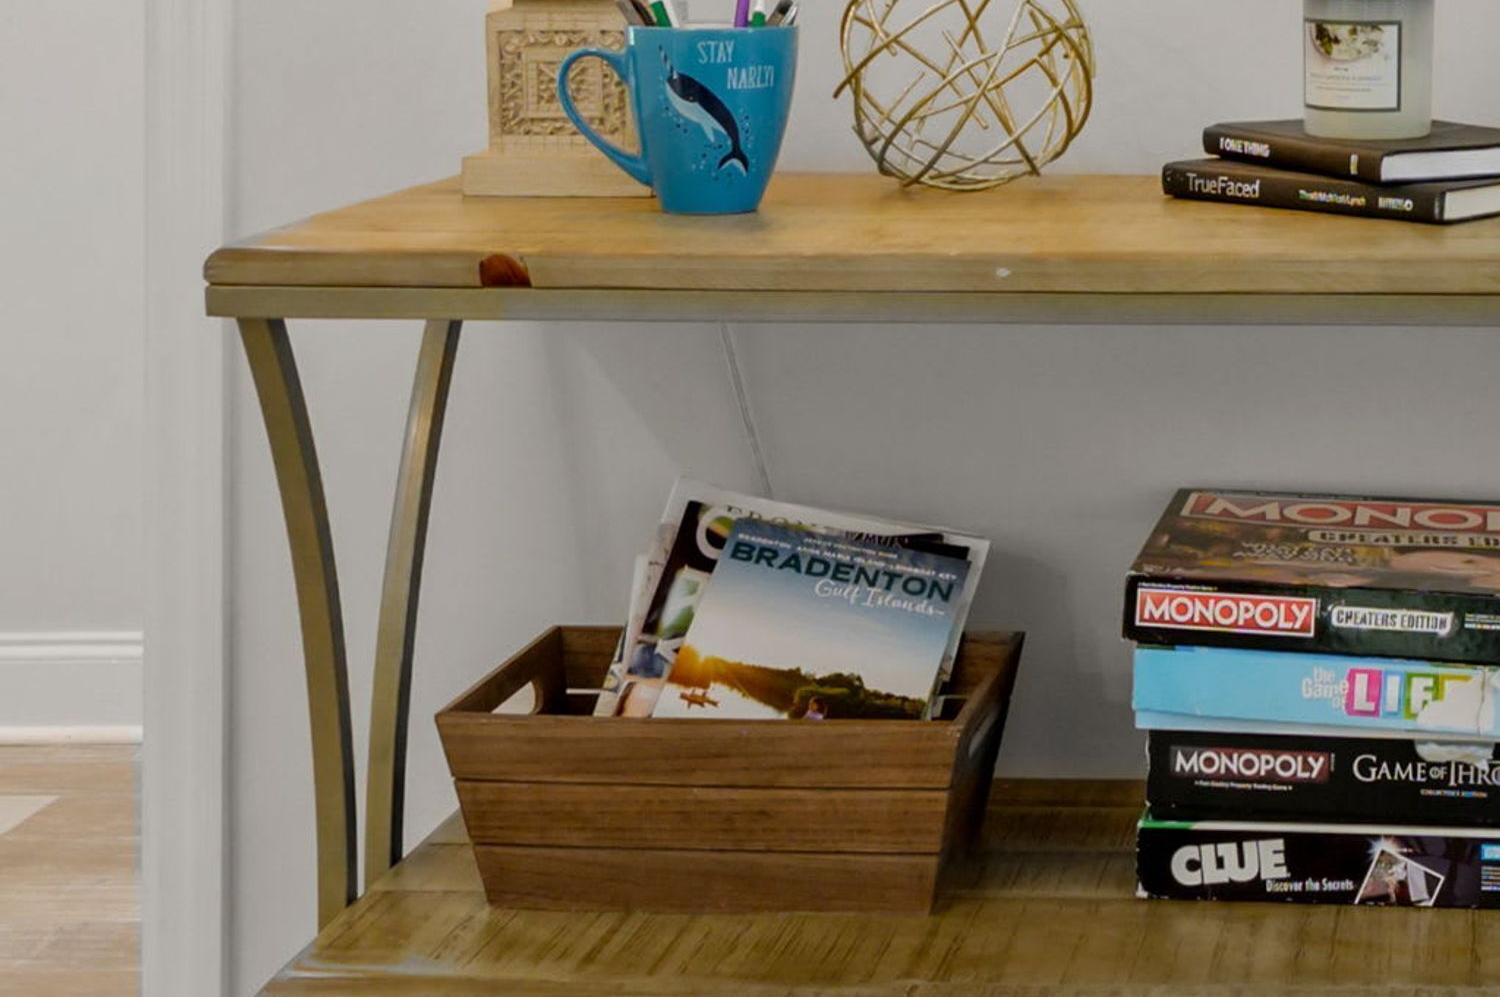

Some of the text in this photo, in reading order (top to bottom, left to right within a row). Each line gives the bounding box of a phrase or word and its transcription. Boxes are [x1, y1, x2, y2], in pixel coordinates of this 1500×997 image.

[696, 40, 735, 65] STAY
[1186, 172, 1261, 199] TrueFaced
[730, 541, 955, 603] BRADENTON
[814, 579, 940, 616] Gulf Islands
[1142, 596, 1310, 630] MONOPOLY
[1336, 609, 1398, 628] CHEATERS
[1400, 613, 1448, 631] EDITION
[1302, 677, 1349, 699] Game
[1313, 667, 1336, 682] the
[1353, 672, 1450, 715] LIF
[1174, 749, 1325, 779] MONOPOLY
[1353, 754, 1427, 783] GAME
[1170, 838, 1288, 887] CLUE
[1266, 877, 1355, 893] Discover the Secrets
